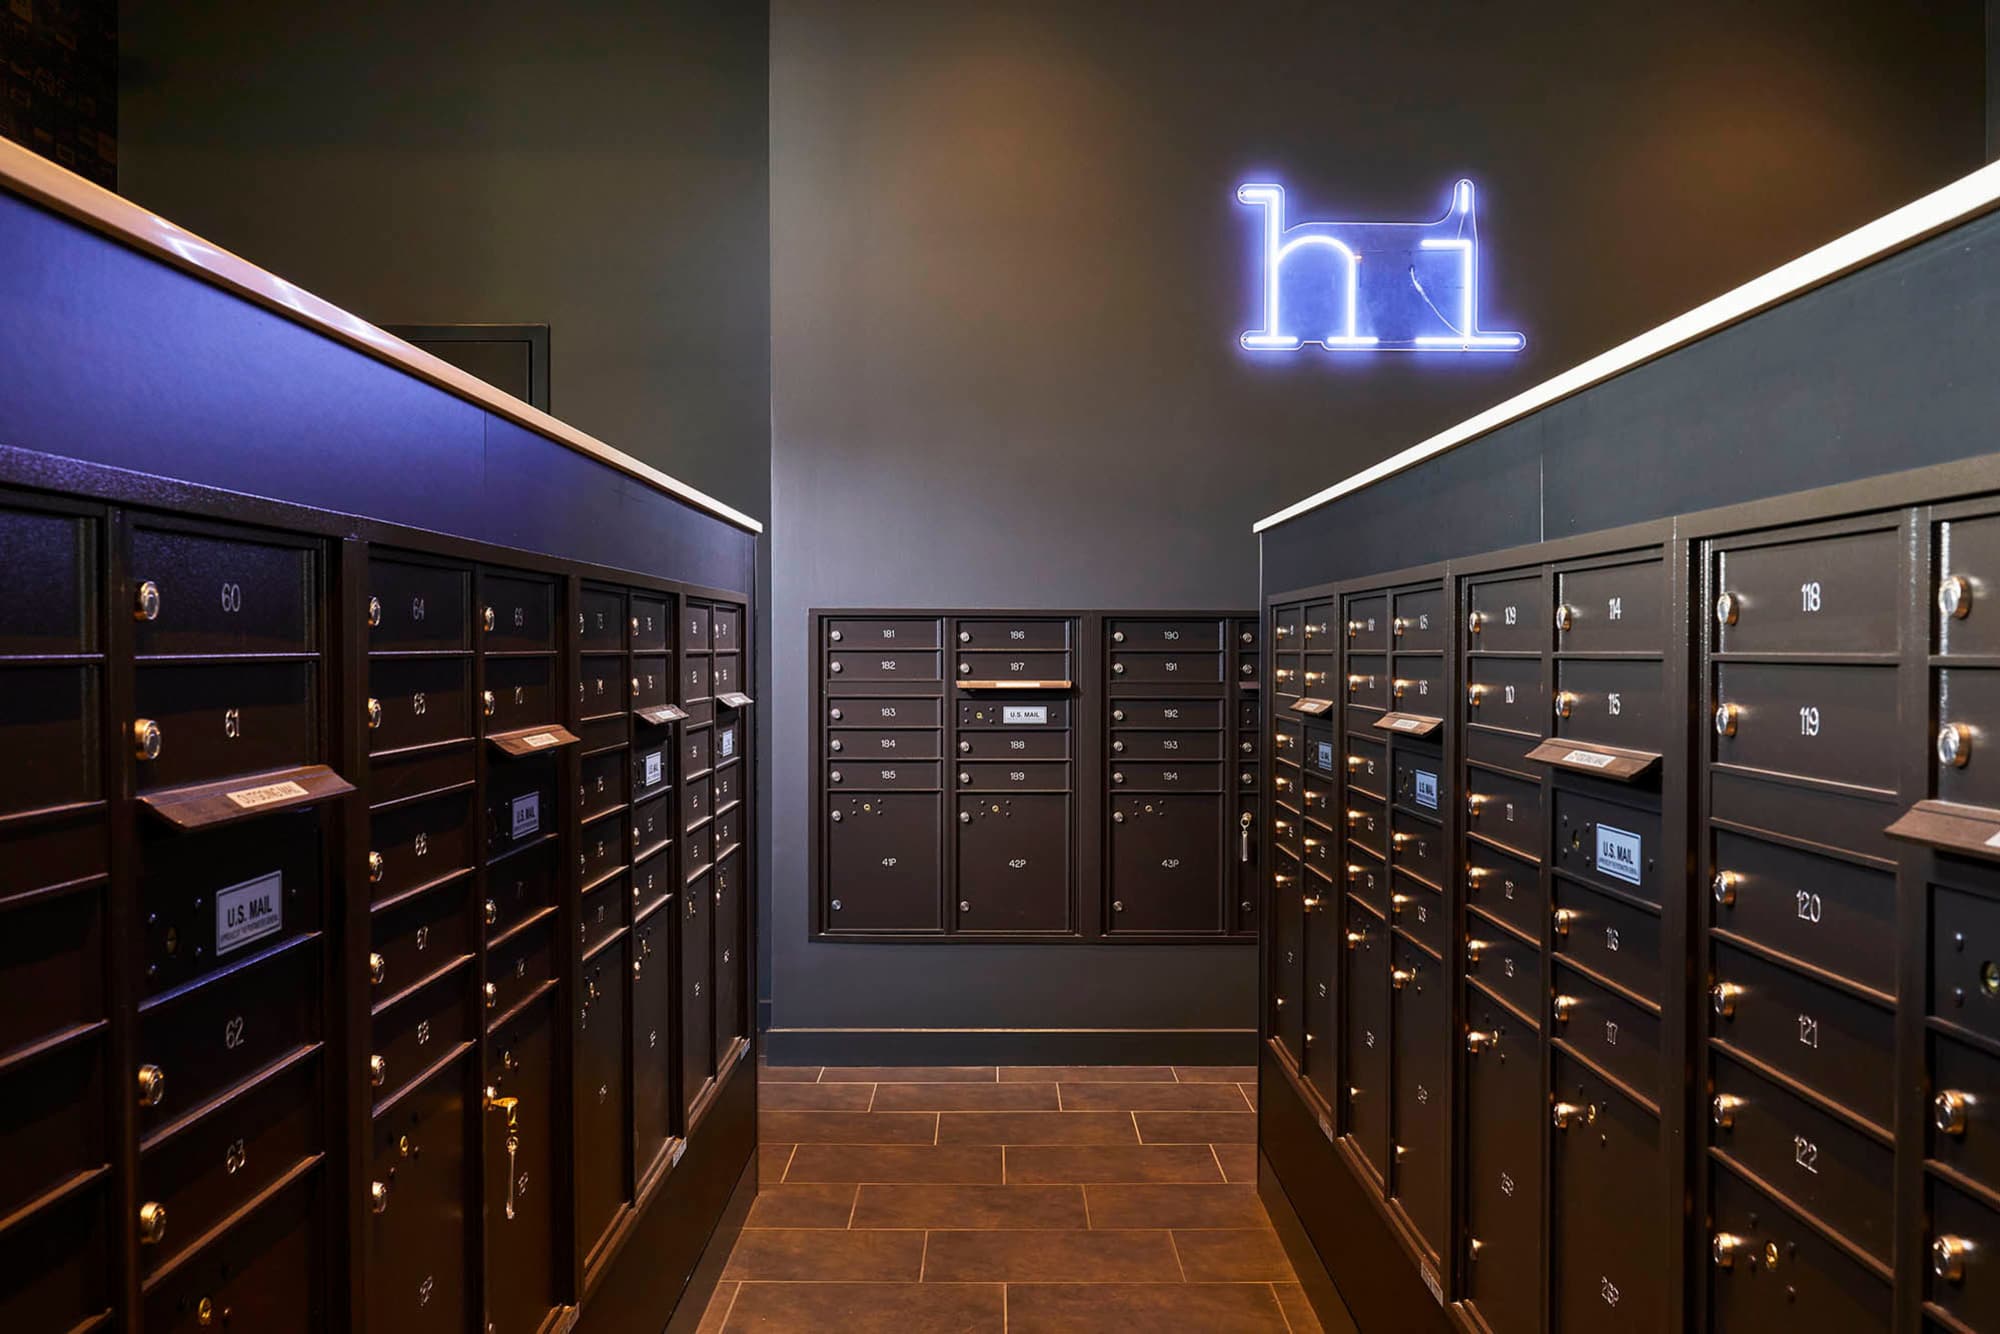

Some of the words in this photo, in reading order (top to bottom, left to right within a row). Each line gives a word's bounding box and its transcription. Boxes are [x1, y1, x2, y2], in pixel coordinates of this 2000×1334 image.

[1241, 180, 1521, 346] hi
[221, 582, 241, 613] 60
[1801, 582, 1821, 612] 118
[412, 597, 425, 620] 64
[1608, 597, 1622, 620] 114
[882, 629, 895, 639] 181
[1010, 630, 1025, 640] 186
[1163, 630, 1180, 640] 190
[881, 660, 896, 670] 182
[1010, 662, 1025, 671] 187
[1165, 662, 1178, 672] 191
[413, 693, 426, 715] 65
[1607, 692, 1621, 716] 115
[881, 707, 897, 717] 183
[1163, 708, 1179, 719] 192
[225, 709, 240, 738] 61
[1799, 706, 1820, 737] 119
[881, 738, 896, 749] 184
[1010, 740, 1025, 750] 188
[1163, 740, 1179, 750] 193
[881, 770, 896, 780] 185
[1010, 771, 1025, 781] 189
[1163, 771, 1178, 781] 194
[1602, 840, 1617, 860] U.S.
[1616, 844, 1634, 865] MAIL
[881, 857, 897, 867] 41P
[1008, 859, 1027, 869] 42P
[1161, 858, 1180, 869] 43P
[227, 904, 247, 928] U.S.
[249, 895, 273, 920] MAIL
[1796, 890, 1821, 923] 120
[225, 1016, 245, 1049] 62
[1798, 1015, 1818, 1049] 121
[226, 1138, 246, 1175] 63
[1793, 1135, 1818, 1174] 122
